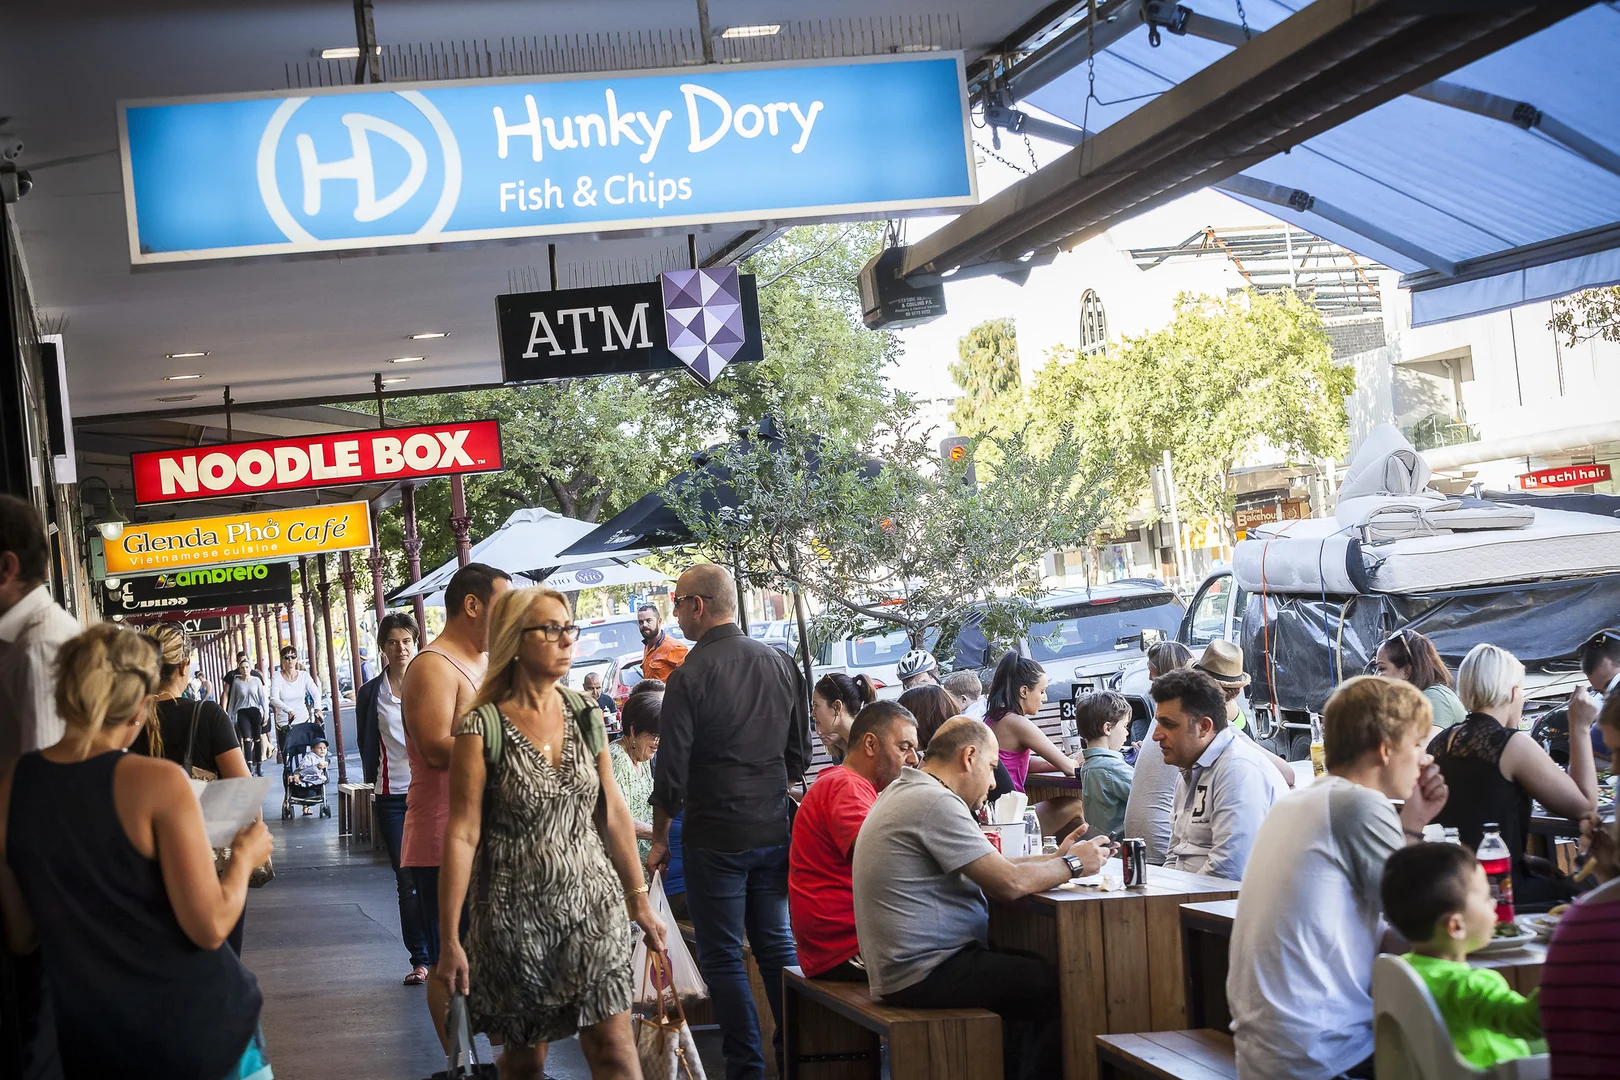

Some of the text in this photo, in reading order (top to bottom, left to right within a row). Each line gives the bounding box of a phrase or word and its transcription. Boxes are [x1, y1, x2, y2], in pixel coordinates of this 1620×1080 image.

[493, 83, 824, 163] Hunky Dory
[296, 113, 428, 222] HD
[499, 171, 692, 212] Fish & Chips
[522, 303, 653, 359] ATM
[159, 441, 362, 495] NOODLE
[371, 429, 475, 474] BOX
[1540, 470, 1576, 484] sechi
[1579, 467, 1605, 479] hair
[123, 527, 219, 554] Glenda
[287, 515, 349, 545] Café
[1237, 509, 1285, 527] Bakehou
[129, 543, 278, 566] Vietnamese cuisine
